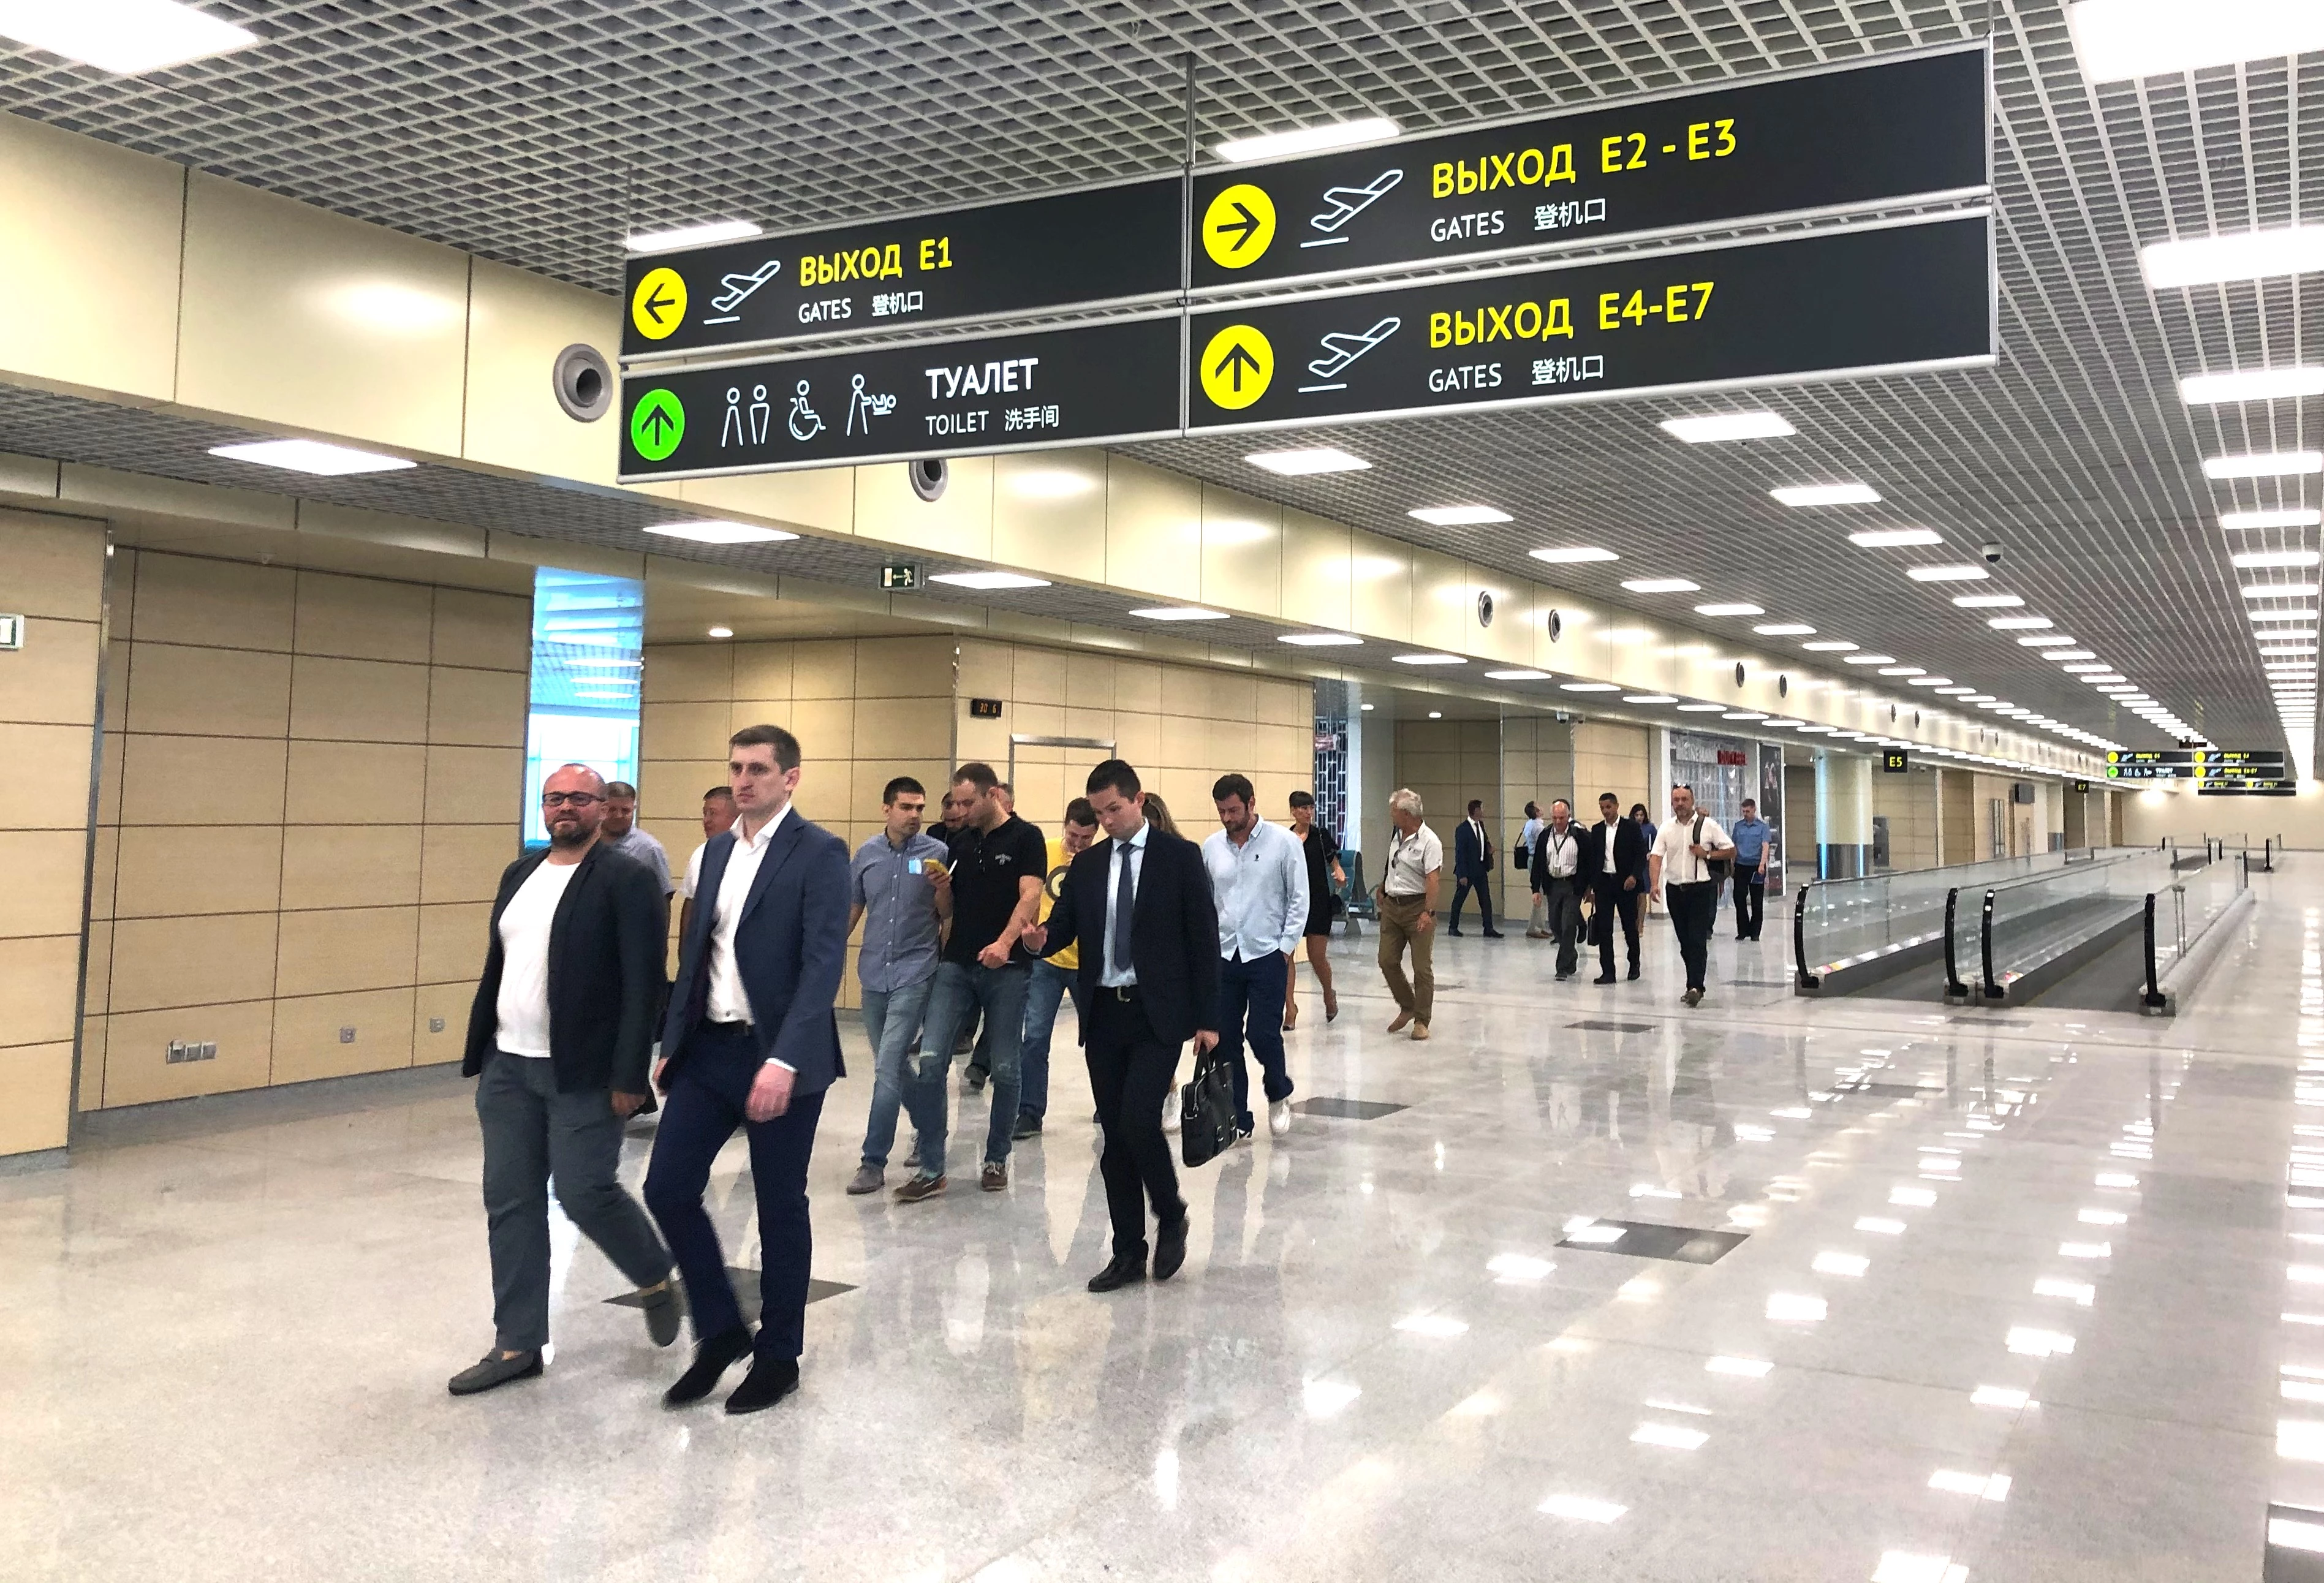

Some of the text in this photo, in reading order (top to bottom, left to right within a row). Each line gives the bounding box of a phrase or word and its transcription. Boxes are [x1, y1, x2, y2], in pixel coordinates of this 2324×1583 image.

[1432, 142, 1576, 199] ВЫХОД
[1602, 132, 1648, 173] E2
[1687, 118, 1738, 161] E3
[1431, 209, 1505, 242] GATES
[1534, 197, 1607, 231] 登机口
[798, 236, 953, 287] ВЫХОД E1
[798, 297, 852, 323] GATES
[871, 290, 924, 317] 登机口
[1429, 281, 1715, 349] ВЫХОД E4-E7
[925, 357, 1039, 400] ТУАЛЕТ
[1428, 363, 1503, 393] GATES
[1531, 355, 1605, 386] 登机口
[925, 409, 990, 437] TOILET
[1004, 404, 1060, 432] 洗手间
[1889, 756, 1902, 768] E5
